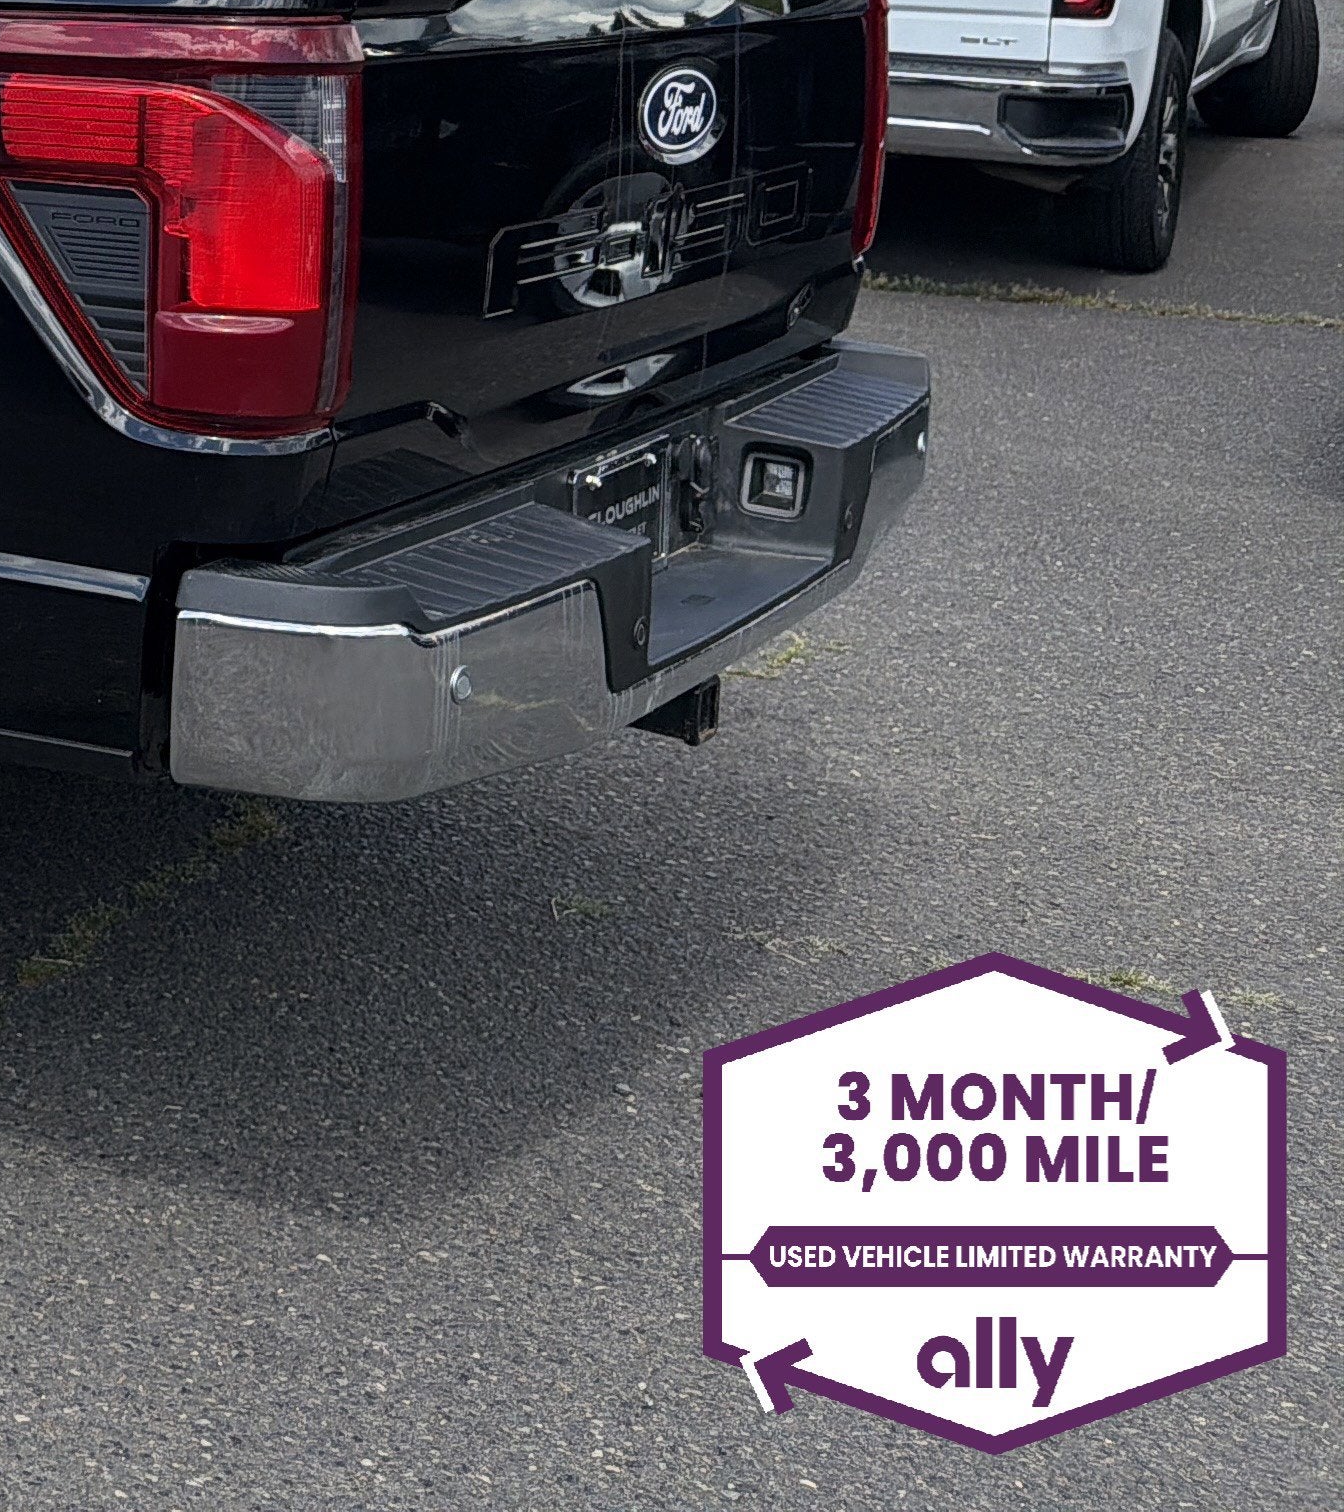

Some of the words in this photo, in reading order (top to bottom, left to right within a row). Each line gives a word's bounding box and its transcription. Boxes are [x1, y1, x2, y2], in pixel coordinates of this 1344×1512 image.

[657, 81, 707, 138] Ford
[51, 212, 140, 228] FORD
[482, 162, 813, 320] F-150
